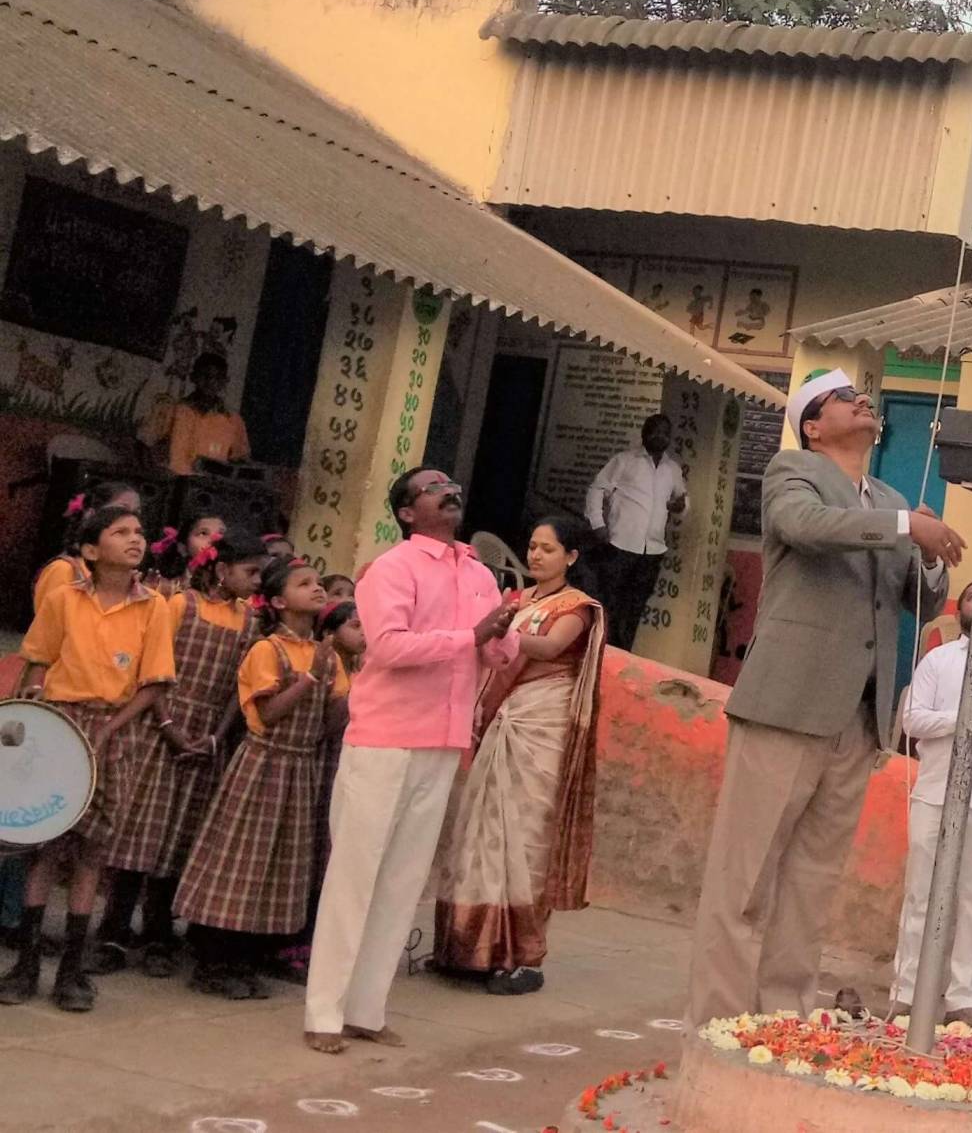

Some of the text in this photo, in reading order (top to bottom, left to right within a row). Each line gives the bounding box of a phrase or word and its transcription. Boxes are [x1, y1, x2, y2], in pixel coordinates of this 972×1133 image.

[344, 330, 373, 352] २७
[412, 348, 426, 366] २०
[340, 355, 368, 382] ३६
[409, 370, 423, 390] ३०
[334, 384, 363, 411] ४५
[405, 392, 419, 412] ४०
[329, 416, 358, 442] ५४
[400, 411, 414, 433] ५०
[321, 448, 347, 479] ६३
[314, 486, 341, 515] ७२
[308, 524, 332, 548] ८१
[663, 555, 682, 574] ०४
[657, 578, 679, 599] १७
